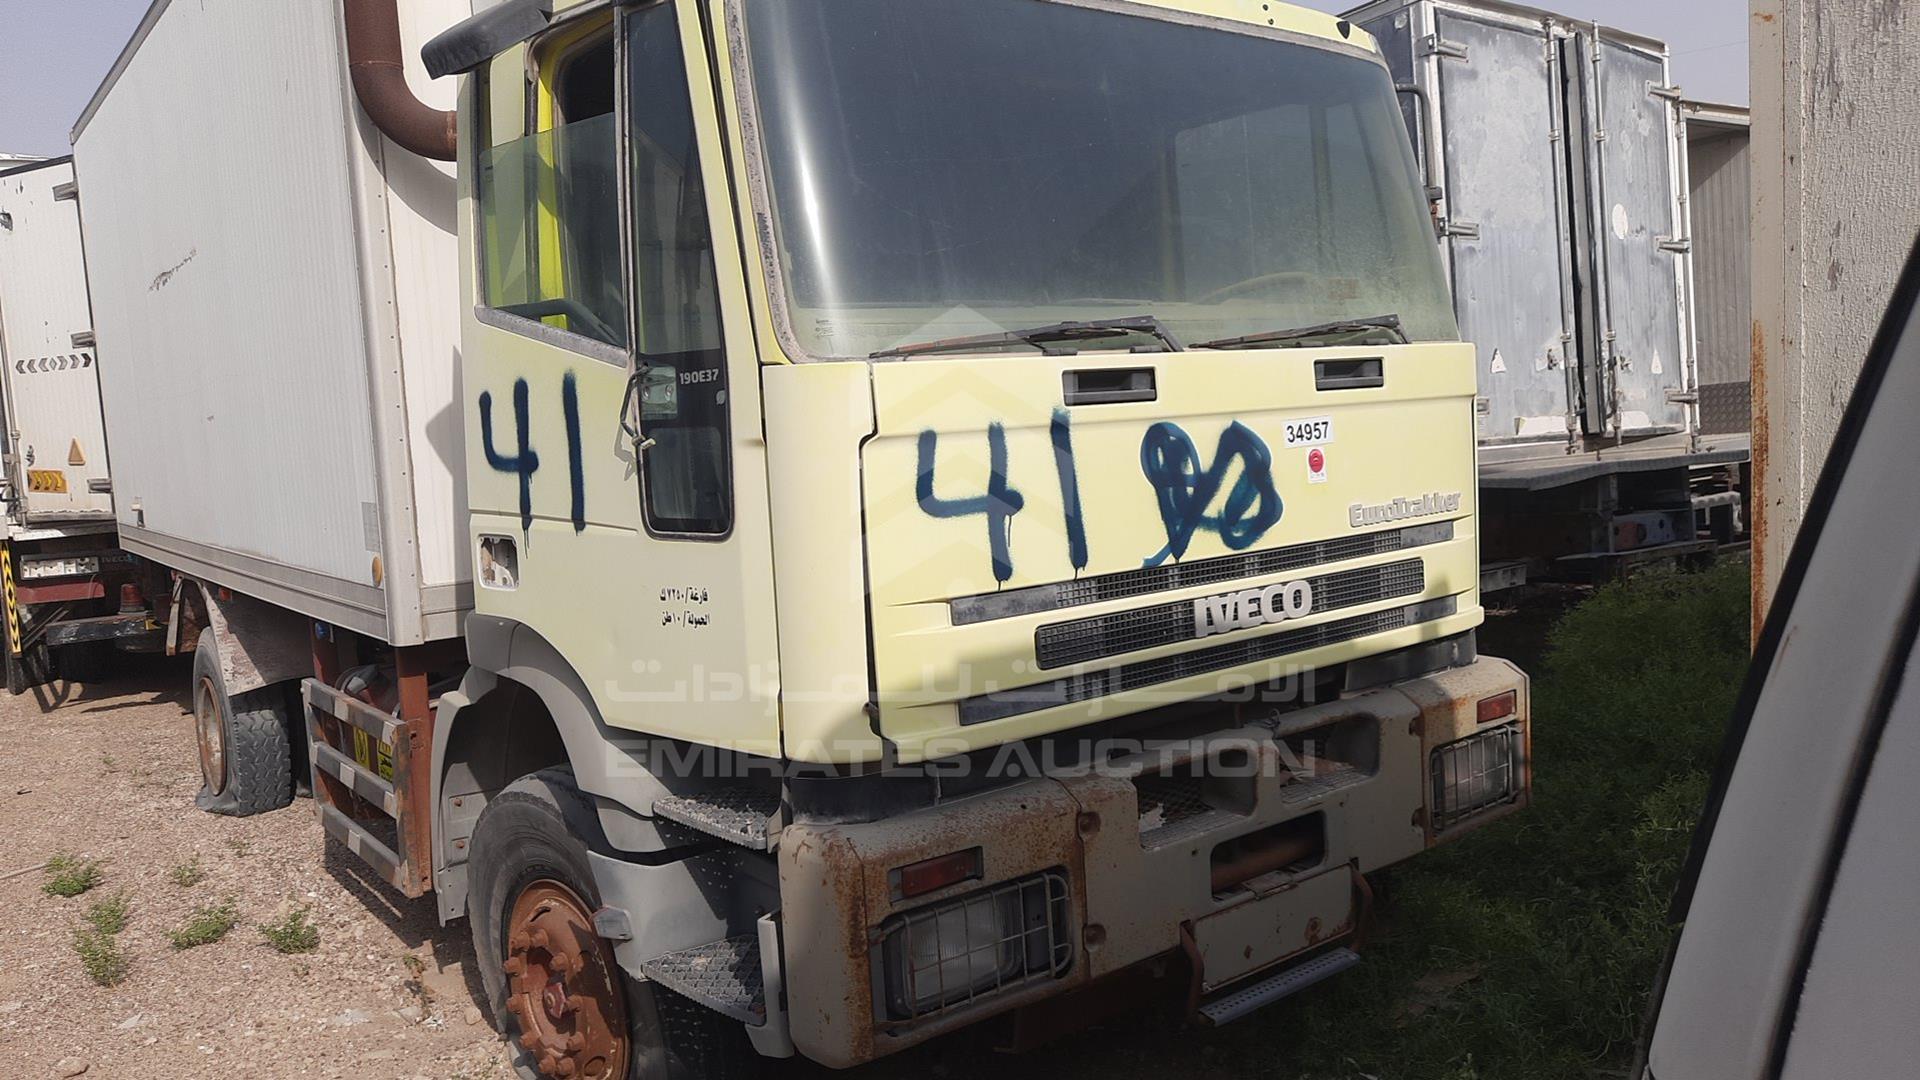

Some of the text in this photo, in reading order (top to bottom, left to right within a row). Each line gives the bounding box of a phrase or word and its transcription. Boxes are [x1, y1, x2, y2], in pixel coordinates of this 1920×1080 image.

[680, 368, 719, 385] 190E37
[479, 369, 586, 538] 41
[1286, 421, 1329, 443] 34957
[915, 406, 1088, 588] 41
[1349, 493, 1461, 528] EuroTrakker
[1194, 580, 1312, 638] IVECO
